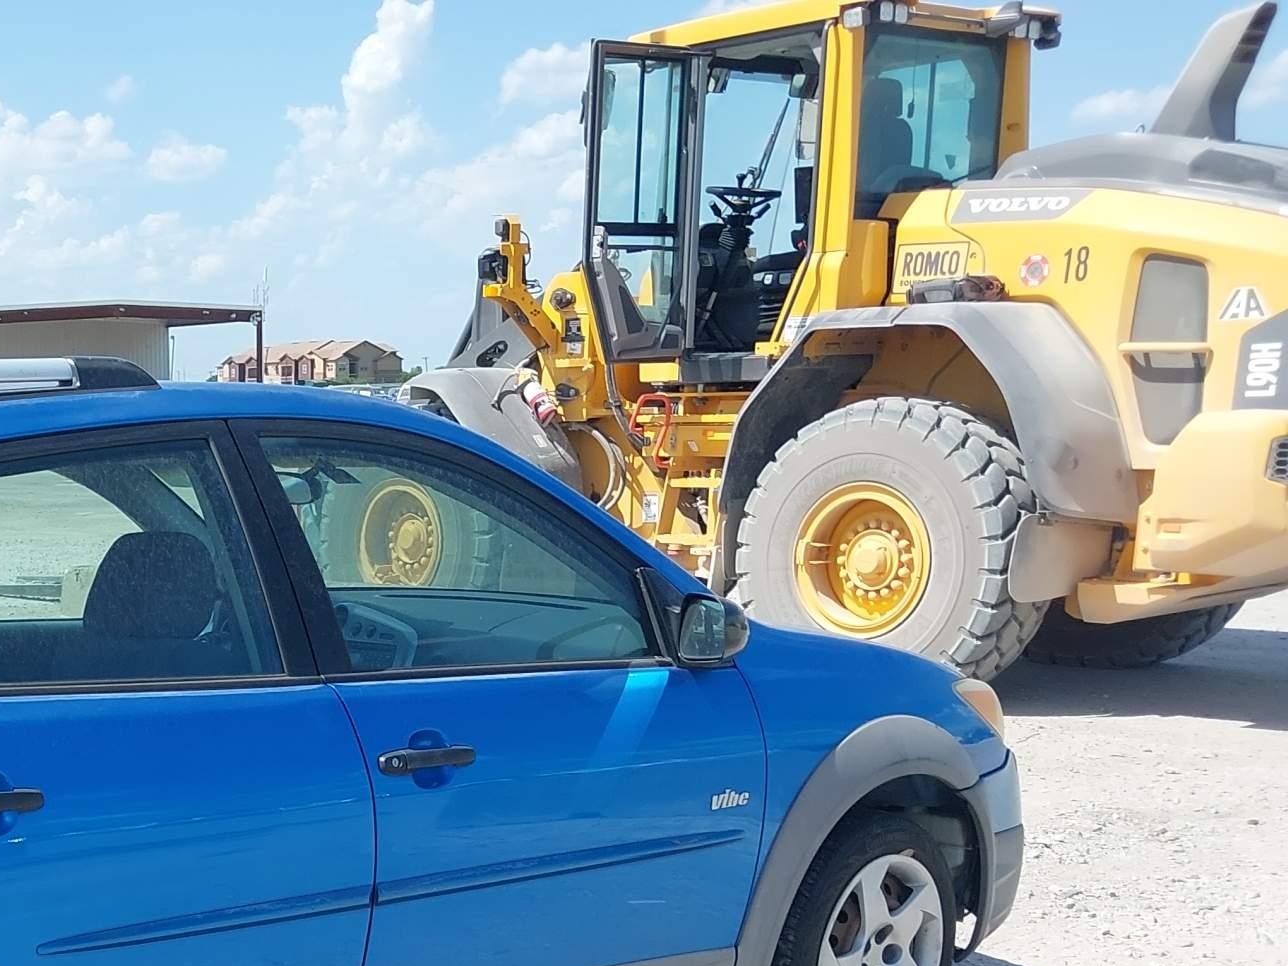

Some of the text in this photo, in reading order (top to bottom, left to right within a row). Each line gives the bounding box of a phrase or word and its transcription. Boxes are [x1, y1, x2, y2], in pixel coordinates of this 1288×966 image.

[968, 196, 1071, 213] VOLVO
[901, 250, 961, 277] ROMCO
[1063, 246, 1090, 284] 18
[1244, 342, 1283, 397] L90H
